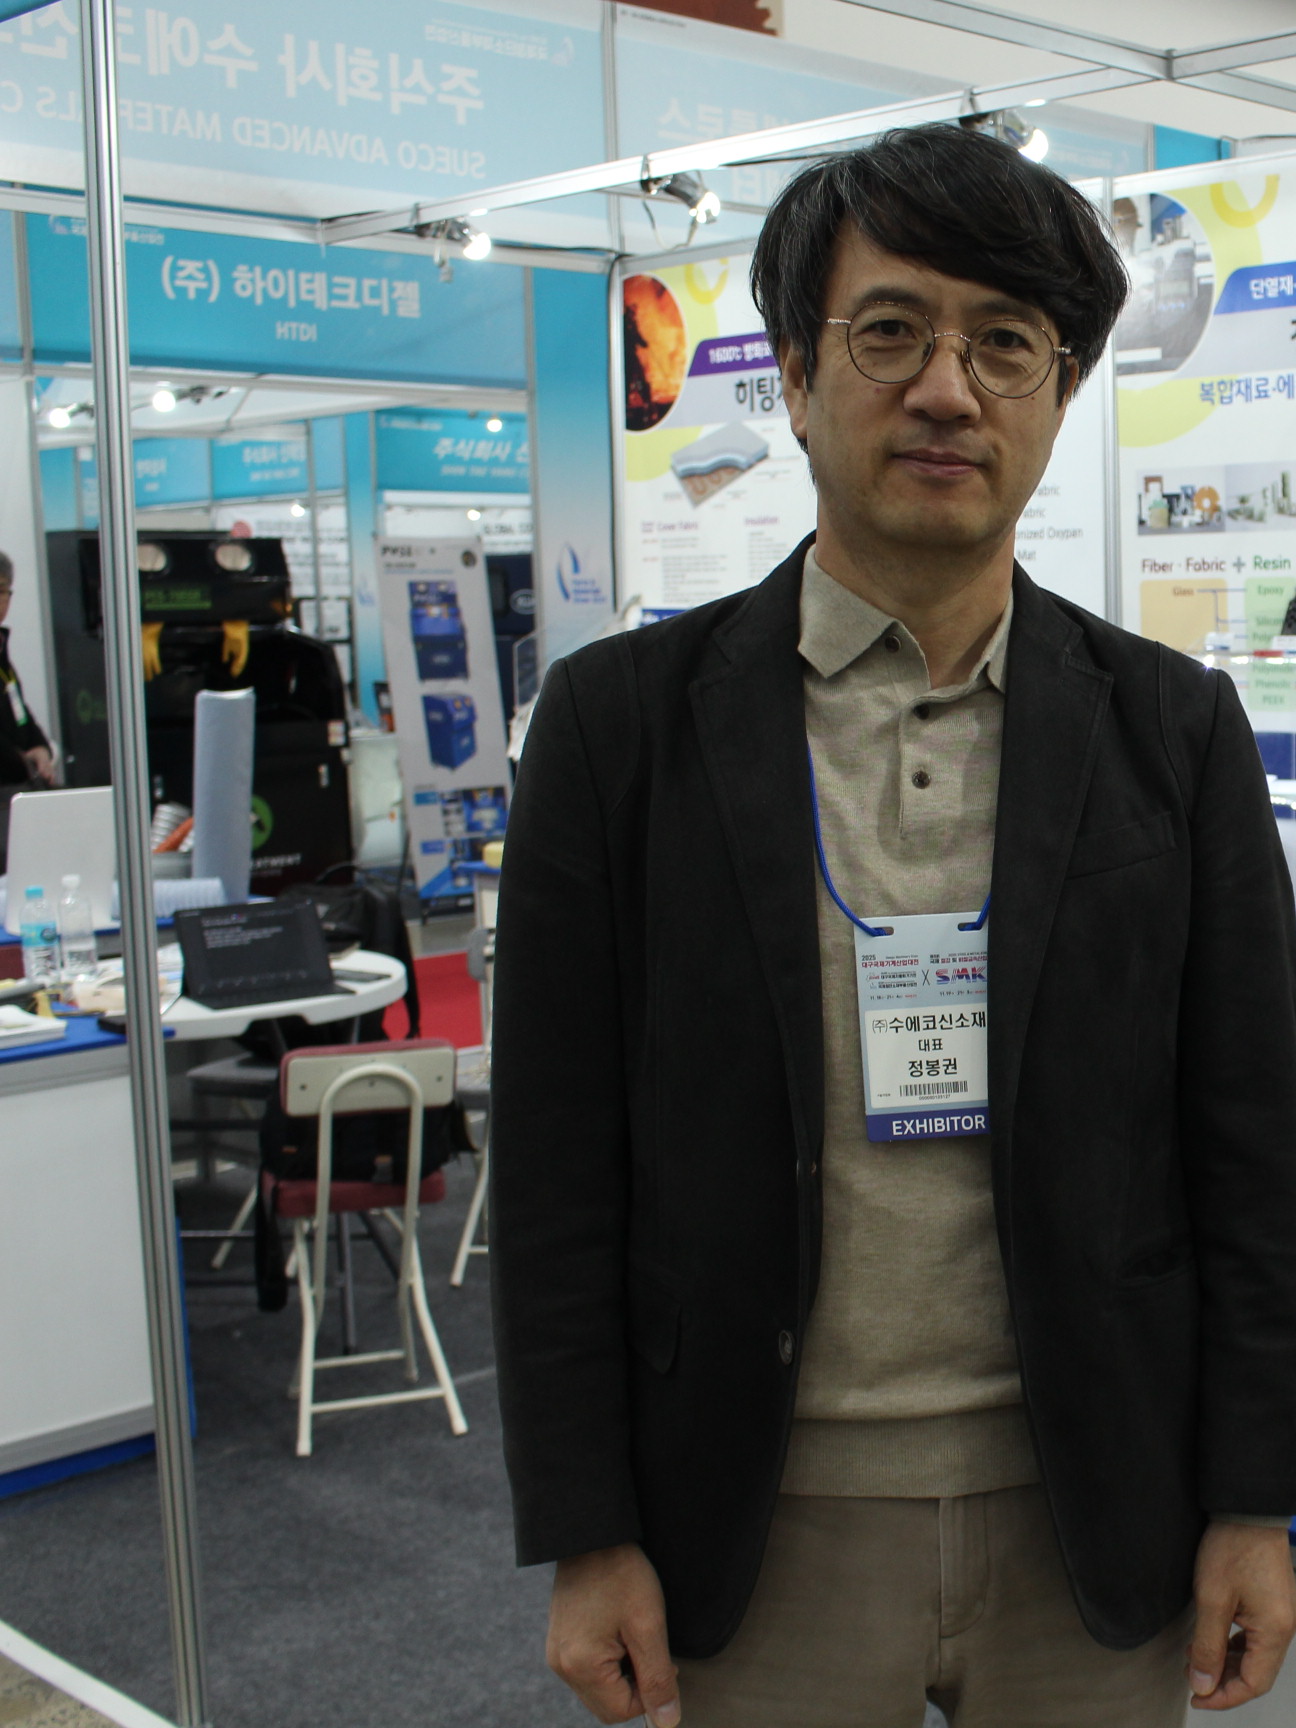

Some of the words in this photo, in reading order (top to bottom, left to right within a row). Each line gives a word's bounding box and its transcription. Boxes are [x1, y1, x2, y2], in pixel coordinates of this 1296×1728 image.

[162, 255, 221, 303] (주)
[232, 264, 422, 319] 하이테크디젤
[276, 321, 317, 342] HTDI
[1141, 558, 1173, 573] Fiber
[1186, 557, 1227, 572] Fabric
[1253, 555, 1291, 571] Resin
[918, 1039, 943, 1052] 대표
[908, 1058, 958, 1078] 정봉권
[892, 1114, 986, 1136] EXHIBITOR
